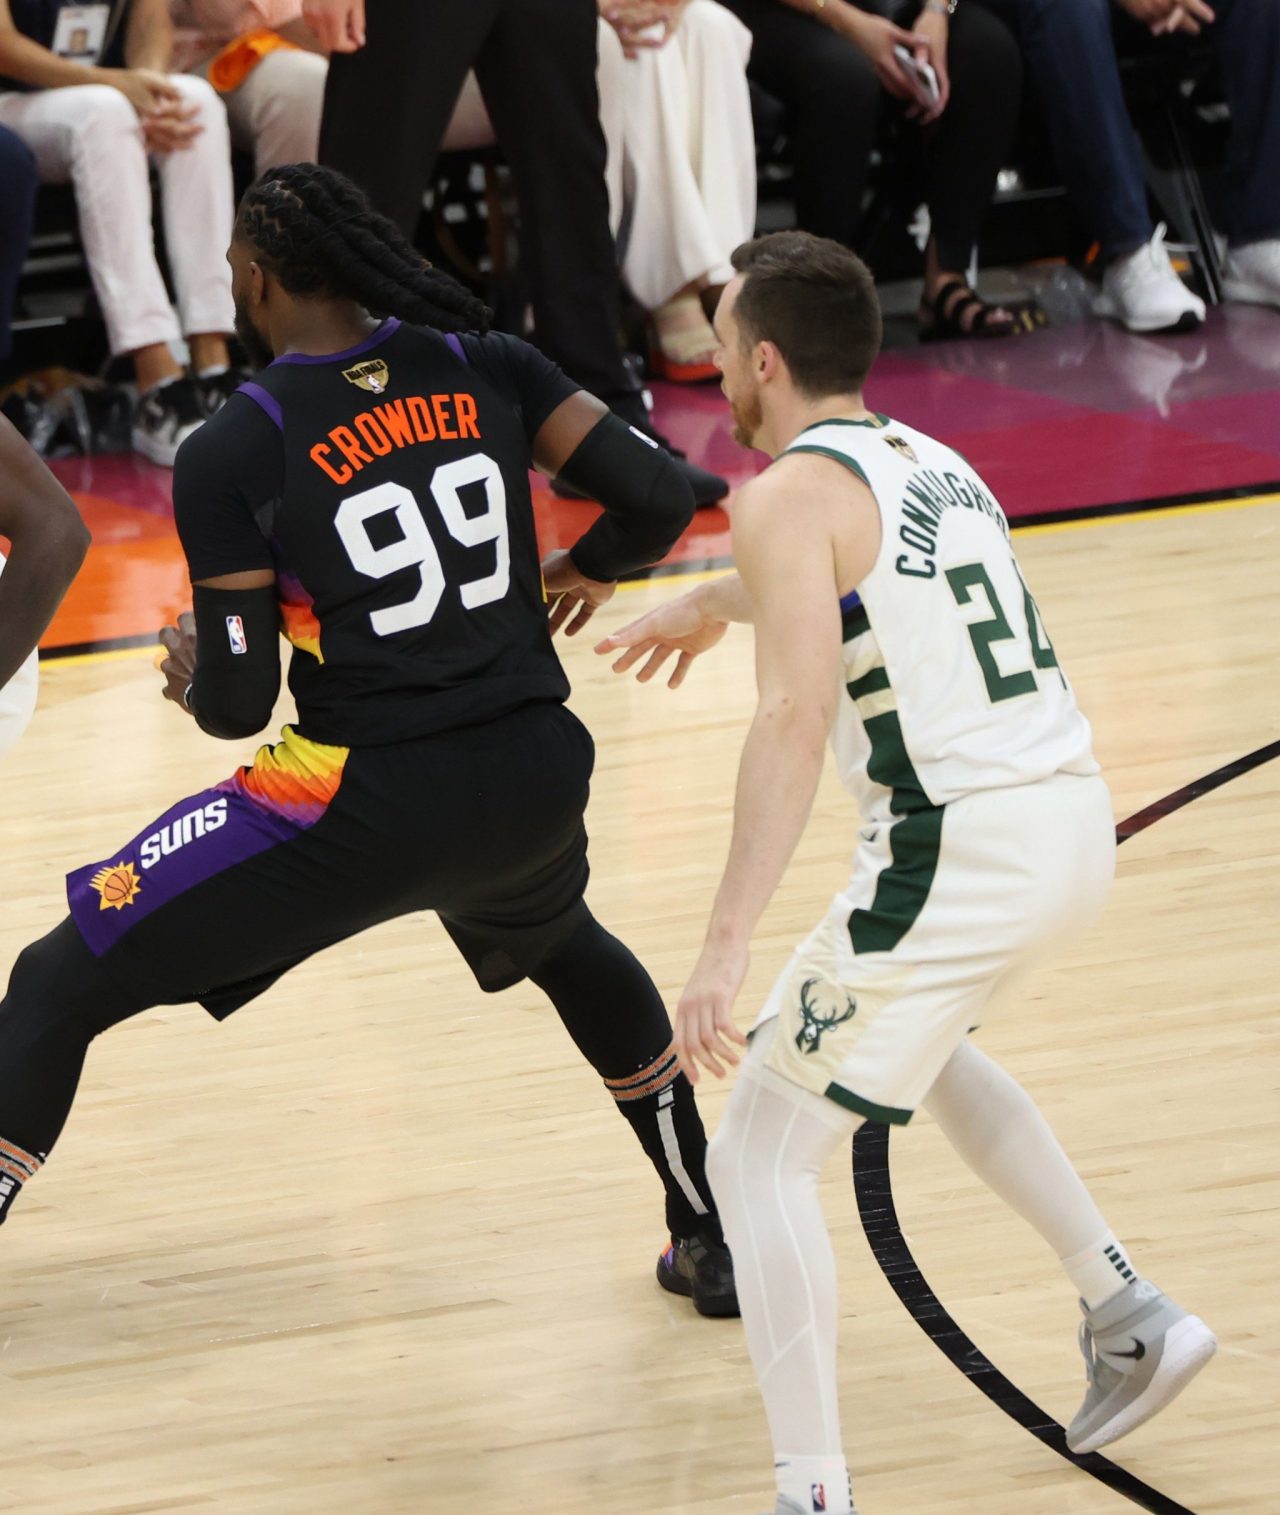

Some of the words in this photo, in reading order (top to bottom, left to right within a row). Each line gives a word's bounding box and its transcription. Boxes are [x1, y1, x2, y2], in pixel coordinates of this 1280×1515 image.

[309, 393, 482, 485] CROWDER
[333, 452, 511, 637] 99
[944, 562, 1068, 704] 24
